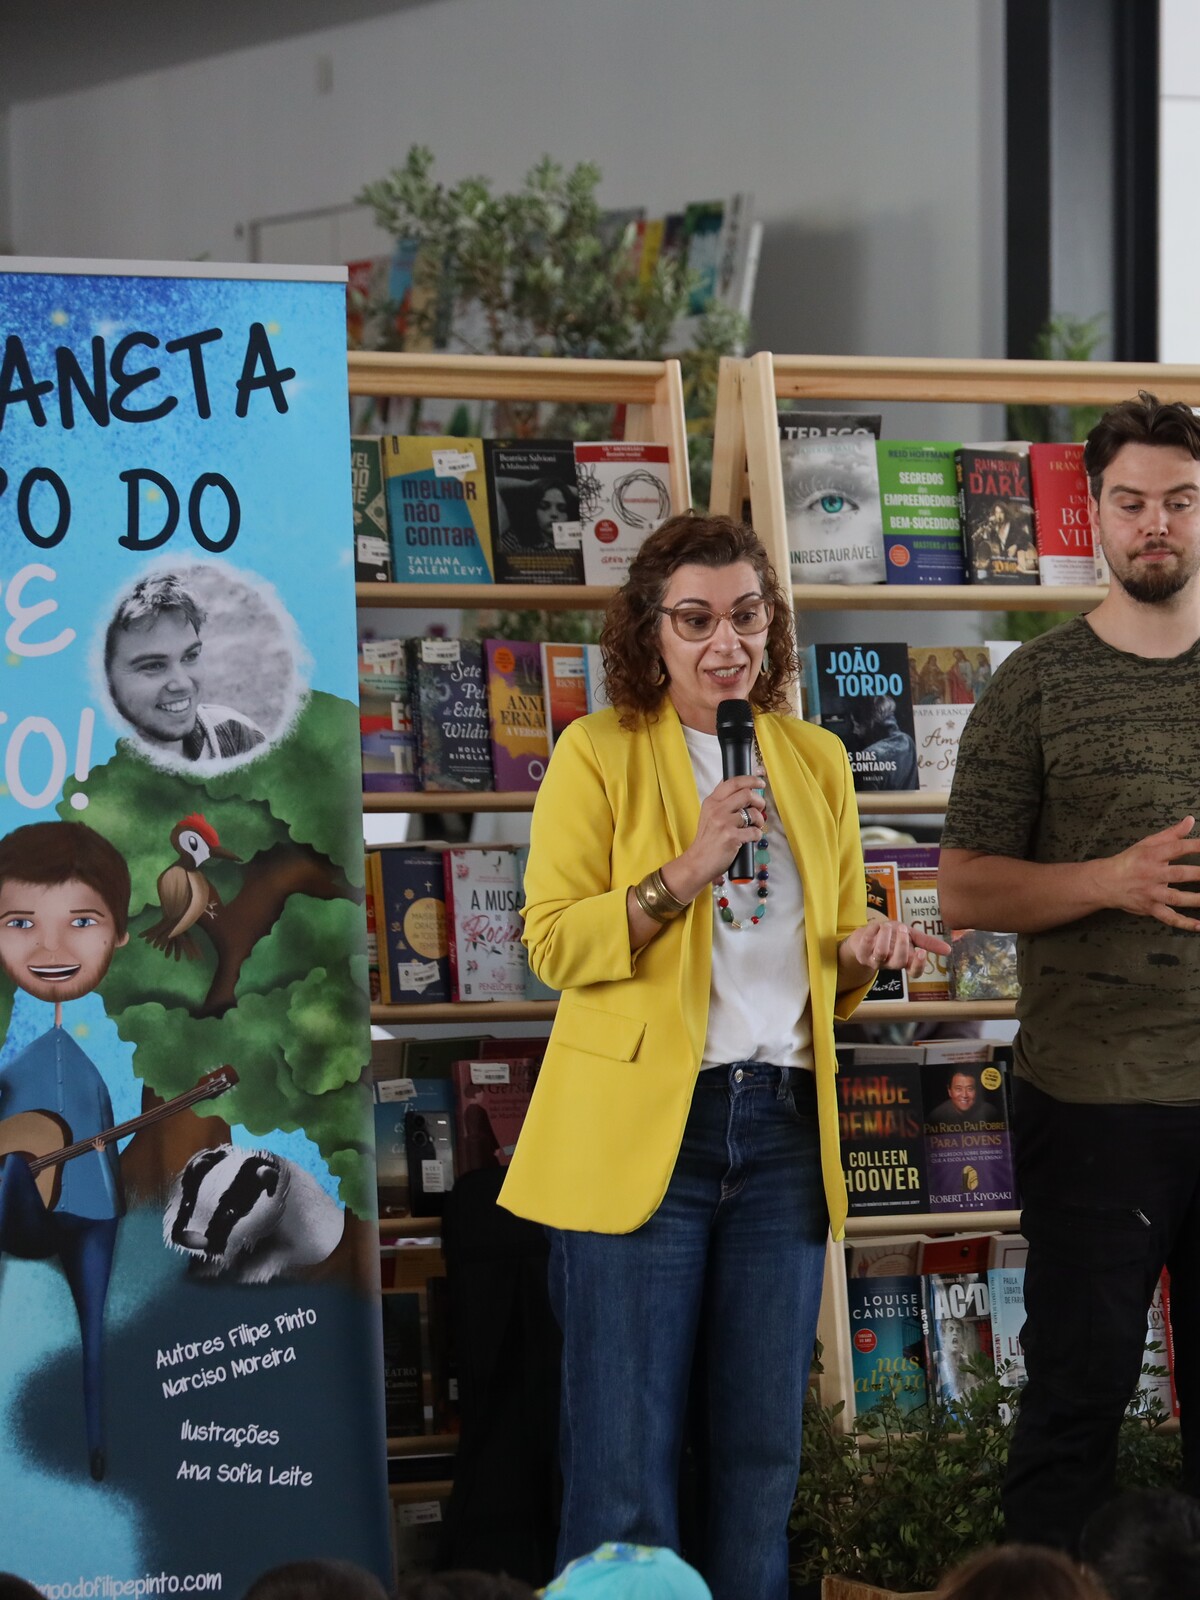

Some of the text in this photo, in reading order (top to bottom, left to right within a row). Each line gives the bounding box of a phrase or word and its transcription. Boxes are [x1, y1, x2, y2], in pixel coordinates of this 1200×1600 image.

[888, 450, 950, 459] REID HOFFMAN
[899, 471, 944, 486] SEGREDOS
[969, 473, 1027, 497] DARK
[0, 466, 241, 552] O DO
[408, 555, 461, 567] TATIANA
[790, 544, 878, 565] INRESTAURÁVEL
[408, 564, 484, 578] SALEM LEVY
[826, 646, 880, 675] JOÃO
[450, 661, 482, 682] Sete
[835, 674, 903, 698] TORDO
[914, 708, 936, 717] PAPA
[855, 751, 877, 762] DIAS
[471, 890, 481, 911] A
[905, 895, 936, 904] A MAIS
[839, 1075, 910, 1106] TARDE
[930, 1134, 1001, 1149] PARA JOVENS
[849, 1149, 908, 1168] COLLEEN
[843, 1167, 920, 1193] HOOVER
[929, 1194, 962, 1205] ROBERT
[973, 1190, 1012, 1202] KIYOSAKI
[1003, 1276, 1017, 1285] PAULA
[1004, 1286, 1021, 1295] LOBATO
[864, 1294, 918, 1307] LOUISE
[155, 1307, 318, 1370] Autores Filipe Pinto
[162, 1343, 297, 1399] Narciso Moreira
[876, 1355, 920, 1374] nas
[181, 1419, 280, 1448] Ilustrações
[176, 1460, 313, 1487] Ana Sofia Leite
